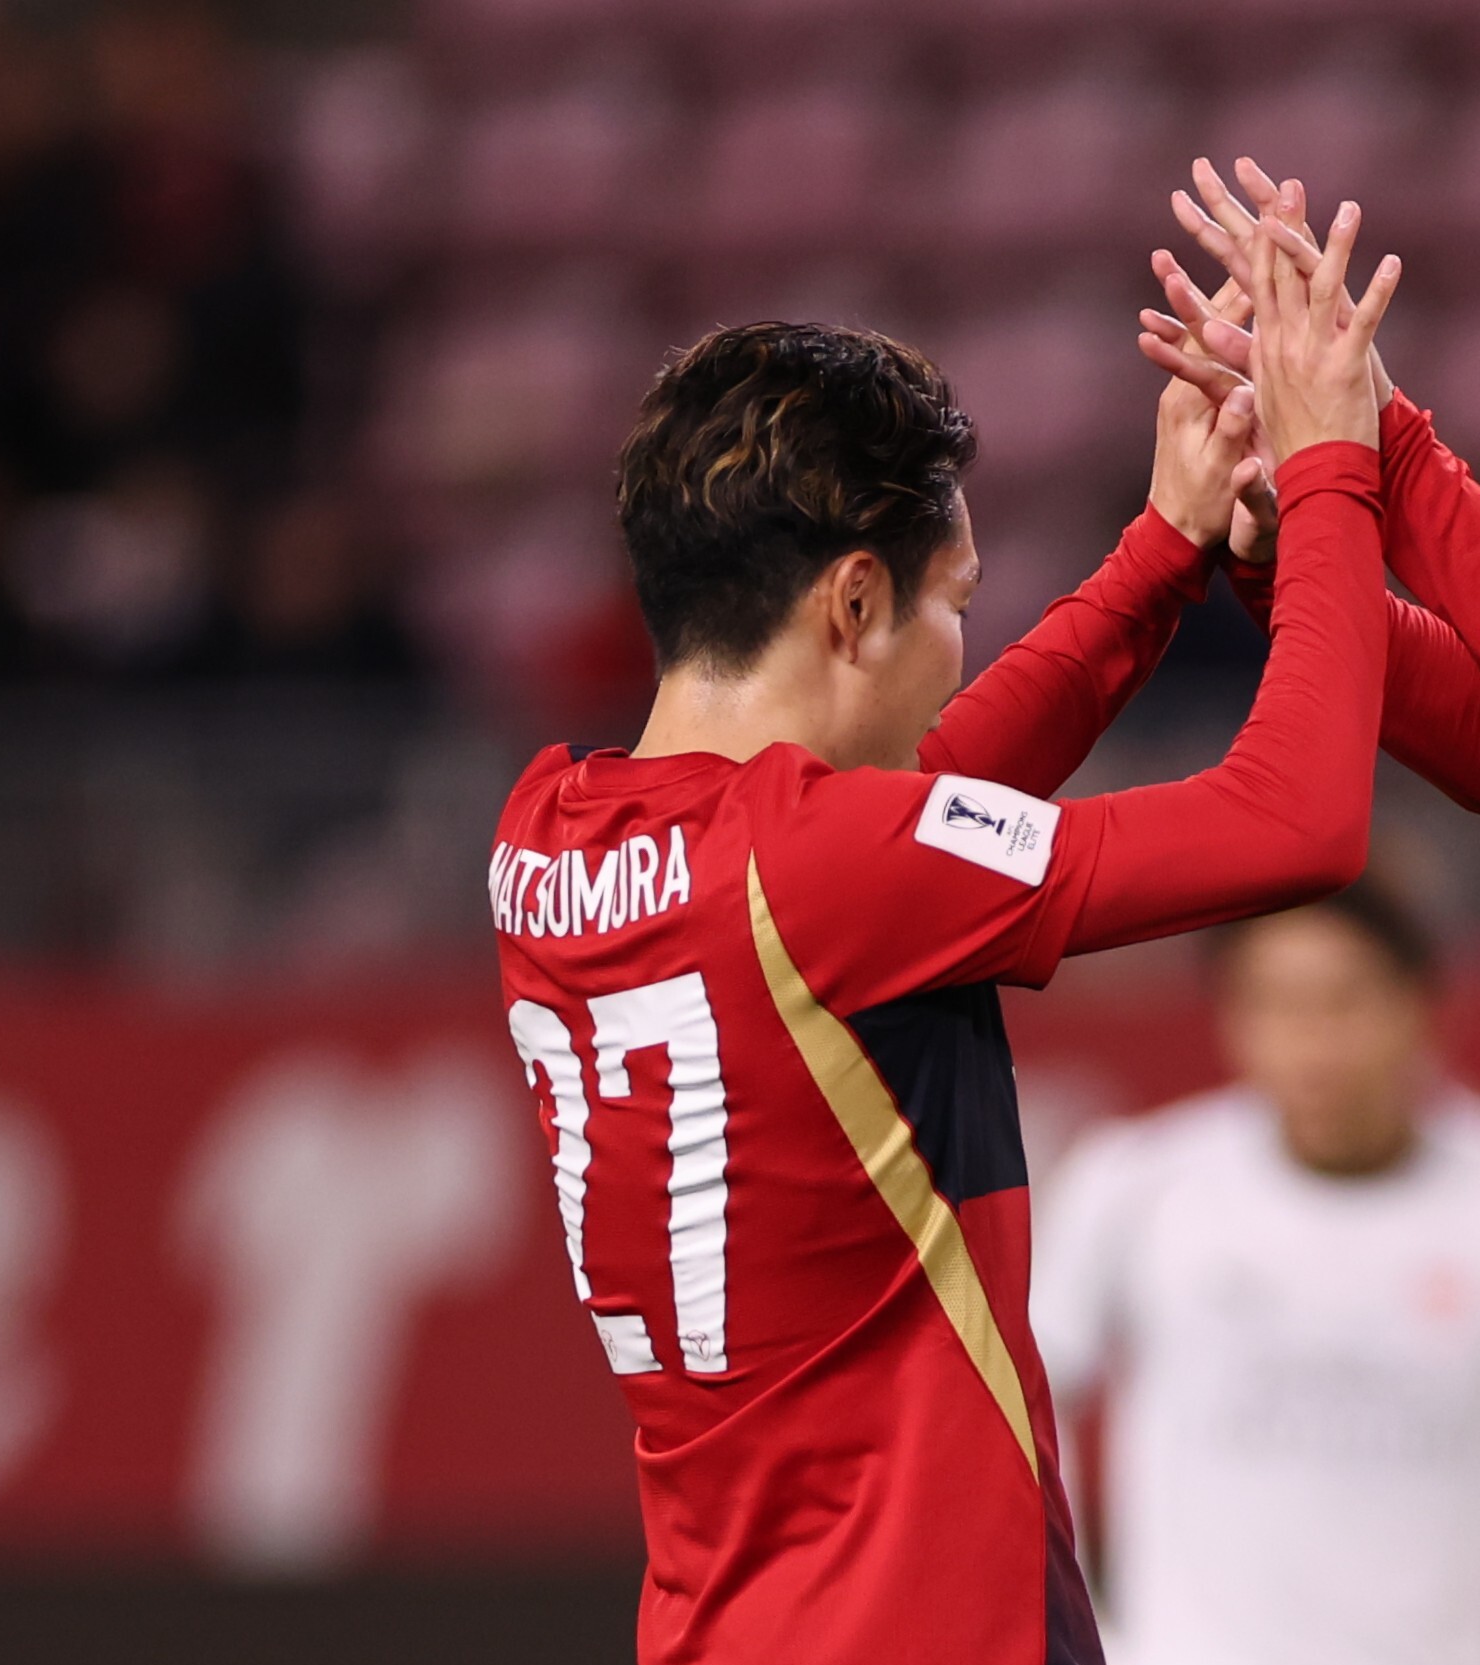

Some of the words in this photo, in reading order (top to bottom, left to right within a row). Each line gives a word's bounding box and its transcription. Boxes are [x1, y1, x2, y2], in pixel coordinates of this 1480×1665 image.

[1006, 811, 1028, 857] CHAMPIONS
[1018, 823, 1033, 851] LEAGUE
[508, 972, 728, 1374] 27
